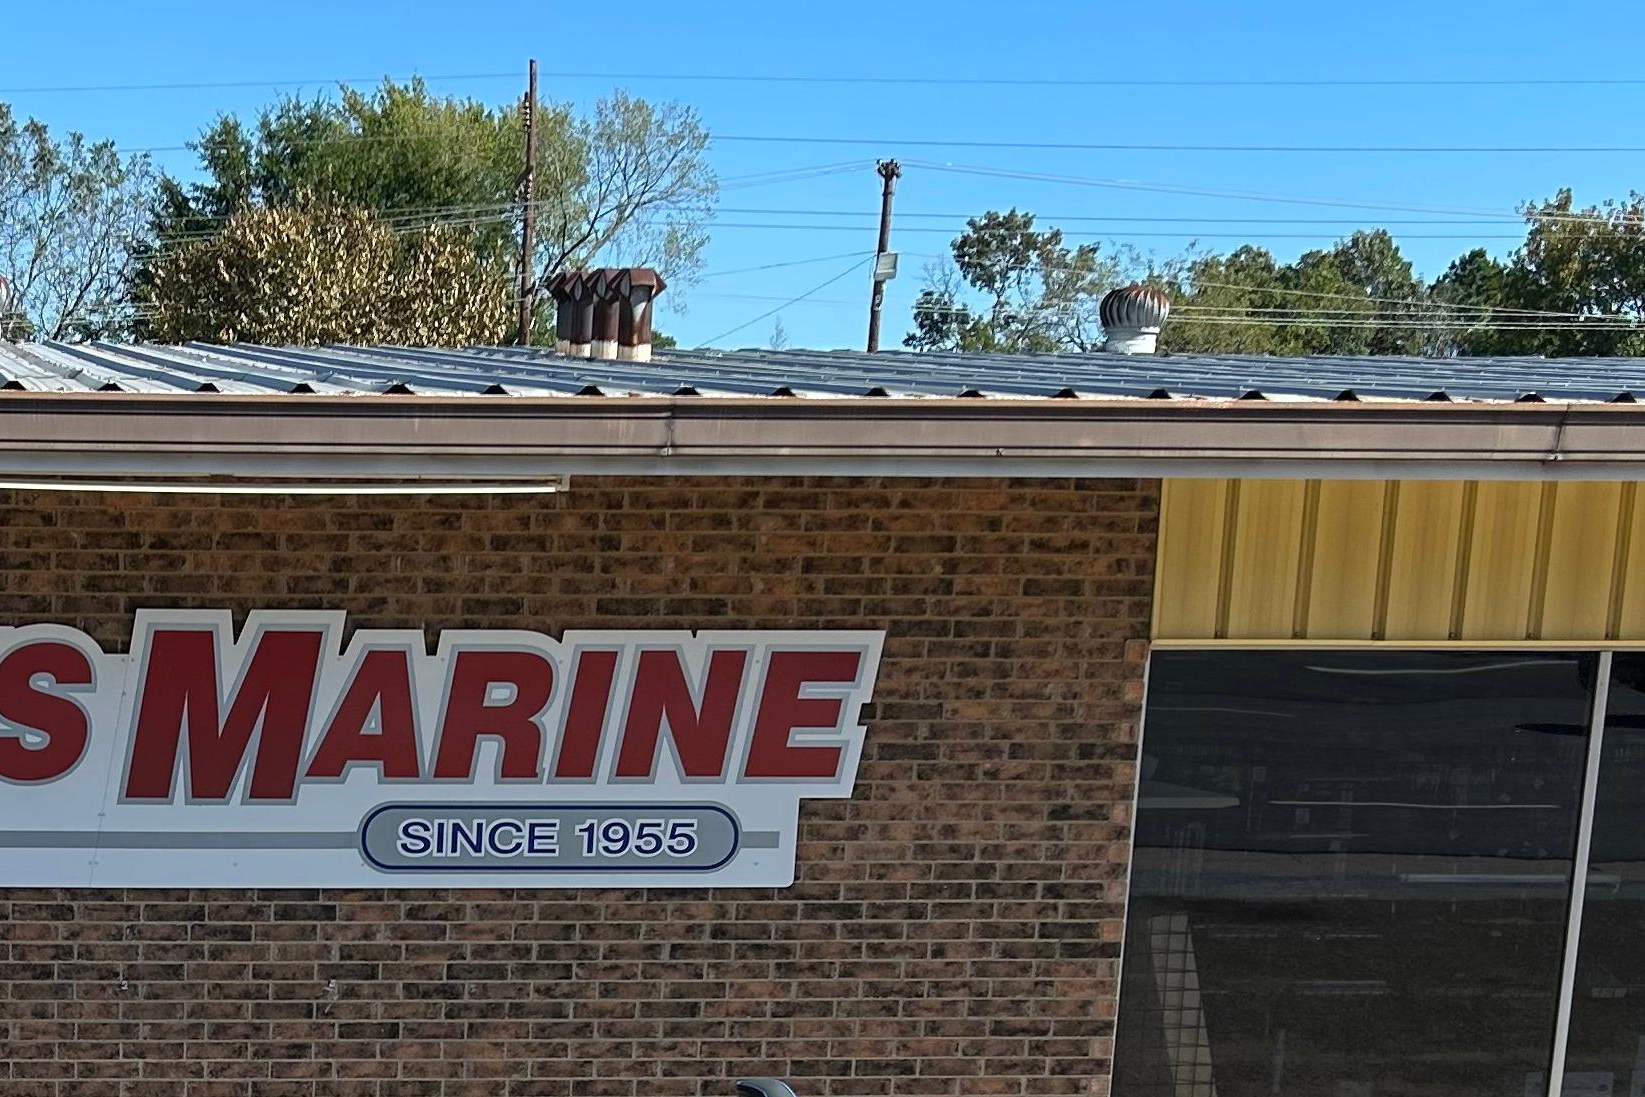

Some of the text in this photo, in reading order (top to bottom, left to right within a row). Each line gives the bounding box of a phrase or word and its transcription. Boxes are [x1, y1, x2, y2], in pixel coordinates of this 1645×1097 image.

[122, 627, 865, 803] MARINE
[396, 817, 698, 858] SINCE 1955
